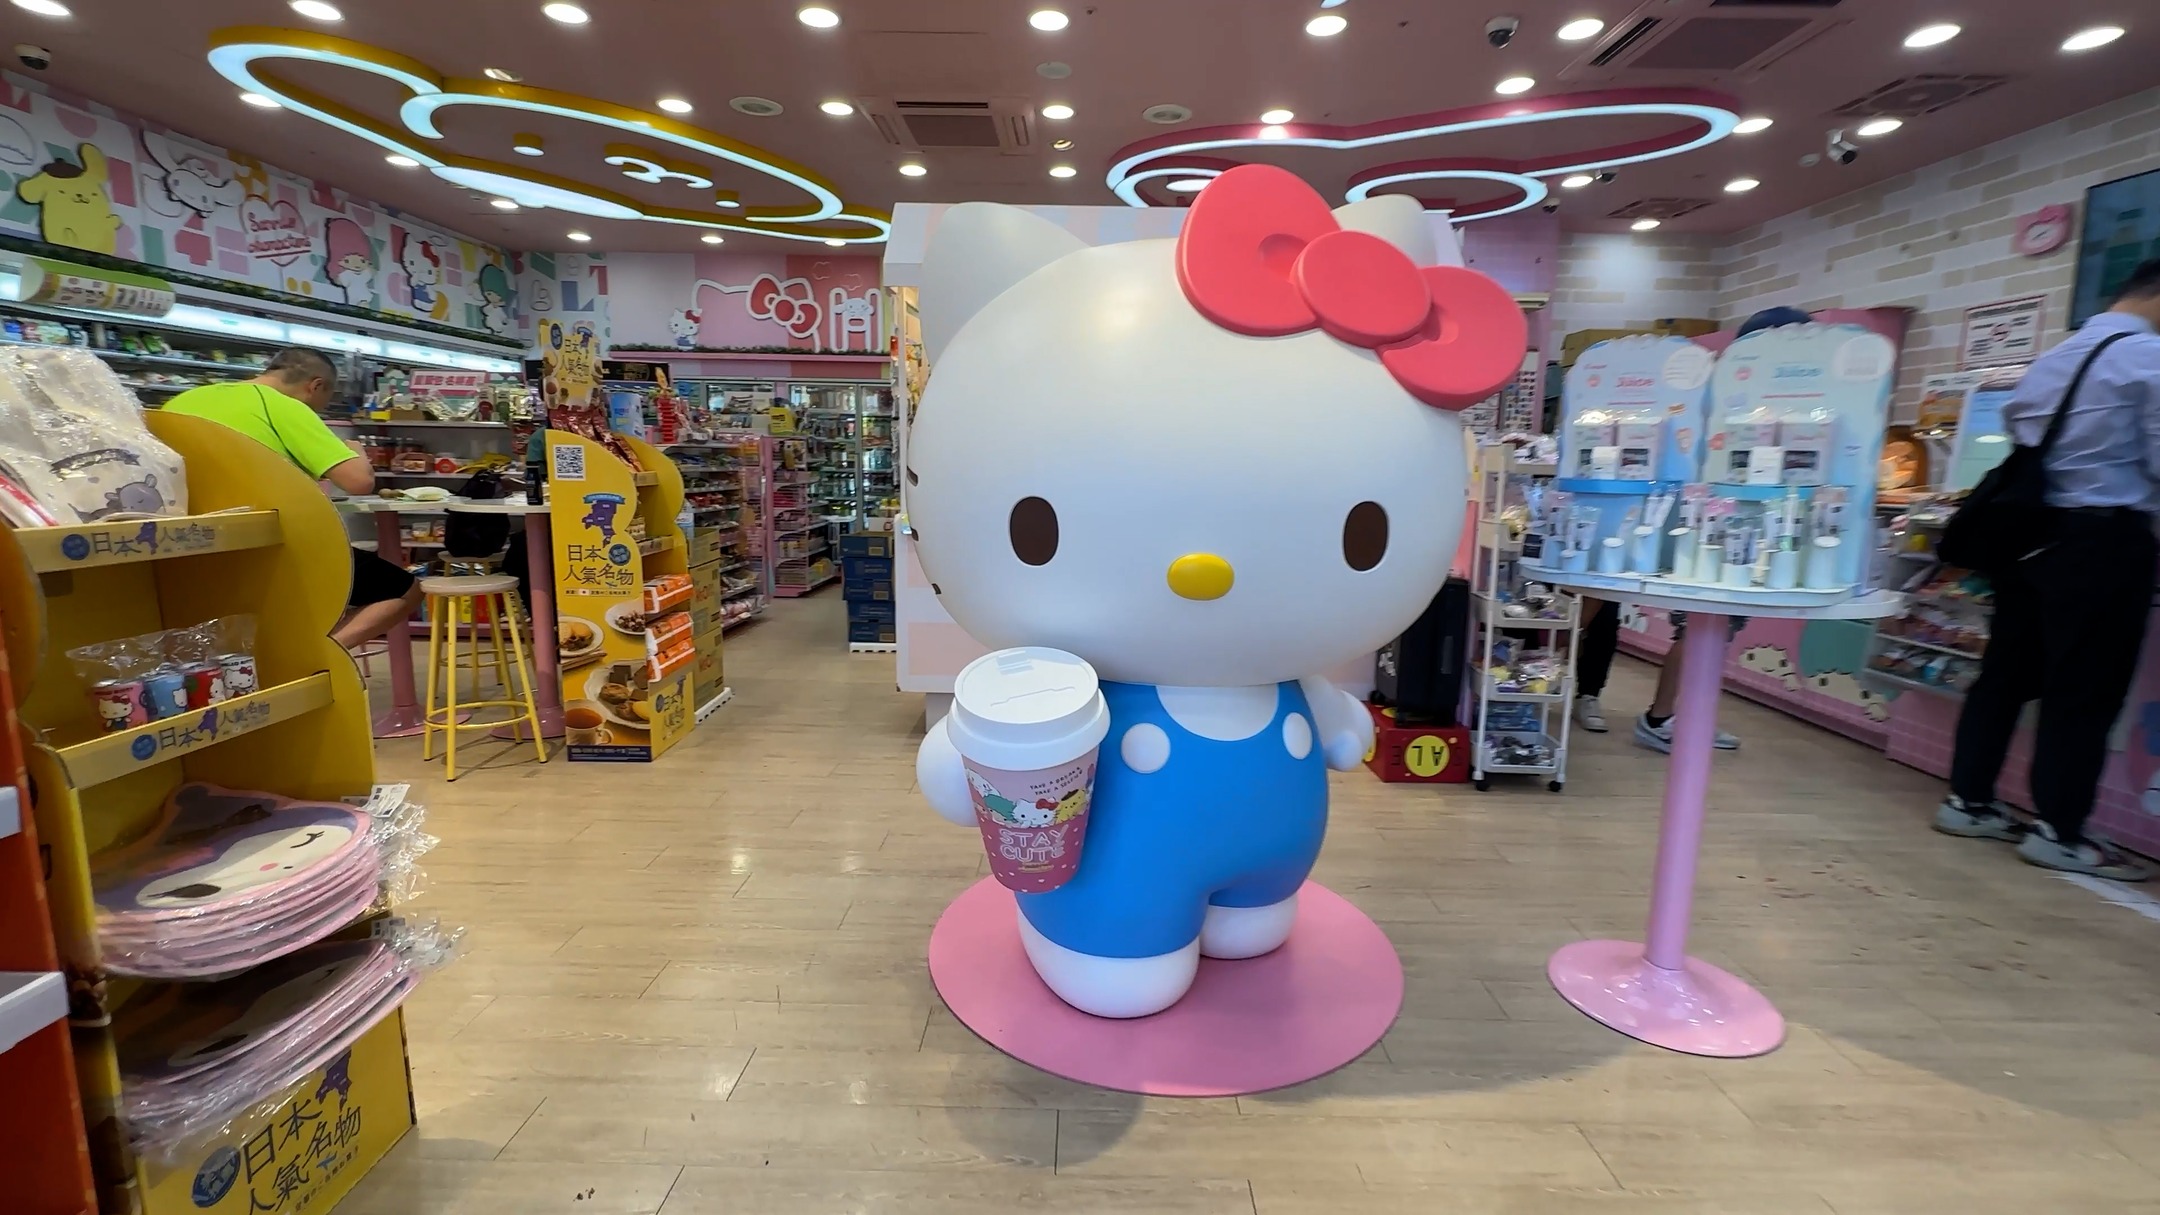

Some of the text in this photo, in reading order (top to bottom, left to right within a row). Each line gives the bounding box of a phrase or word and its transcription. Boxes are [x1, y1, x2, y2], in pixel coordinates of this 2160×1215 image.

[91, 531, 142, 557] 日本
[568, 544, 607, 562] 日本
[563, 563, 634, 586] 人氣名物
[158, 726, 203, 750] 日本
[999, 824, 1069, 848] STAY
[1000, 841, 1066, 862] CUTE
[242, 1098, 323, 1184] 日本
[249, 1106, 361, 1215] 人氣名物
